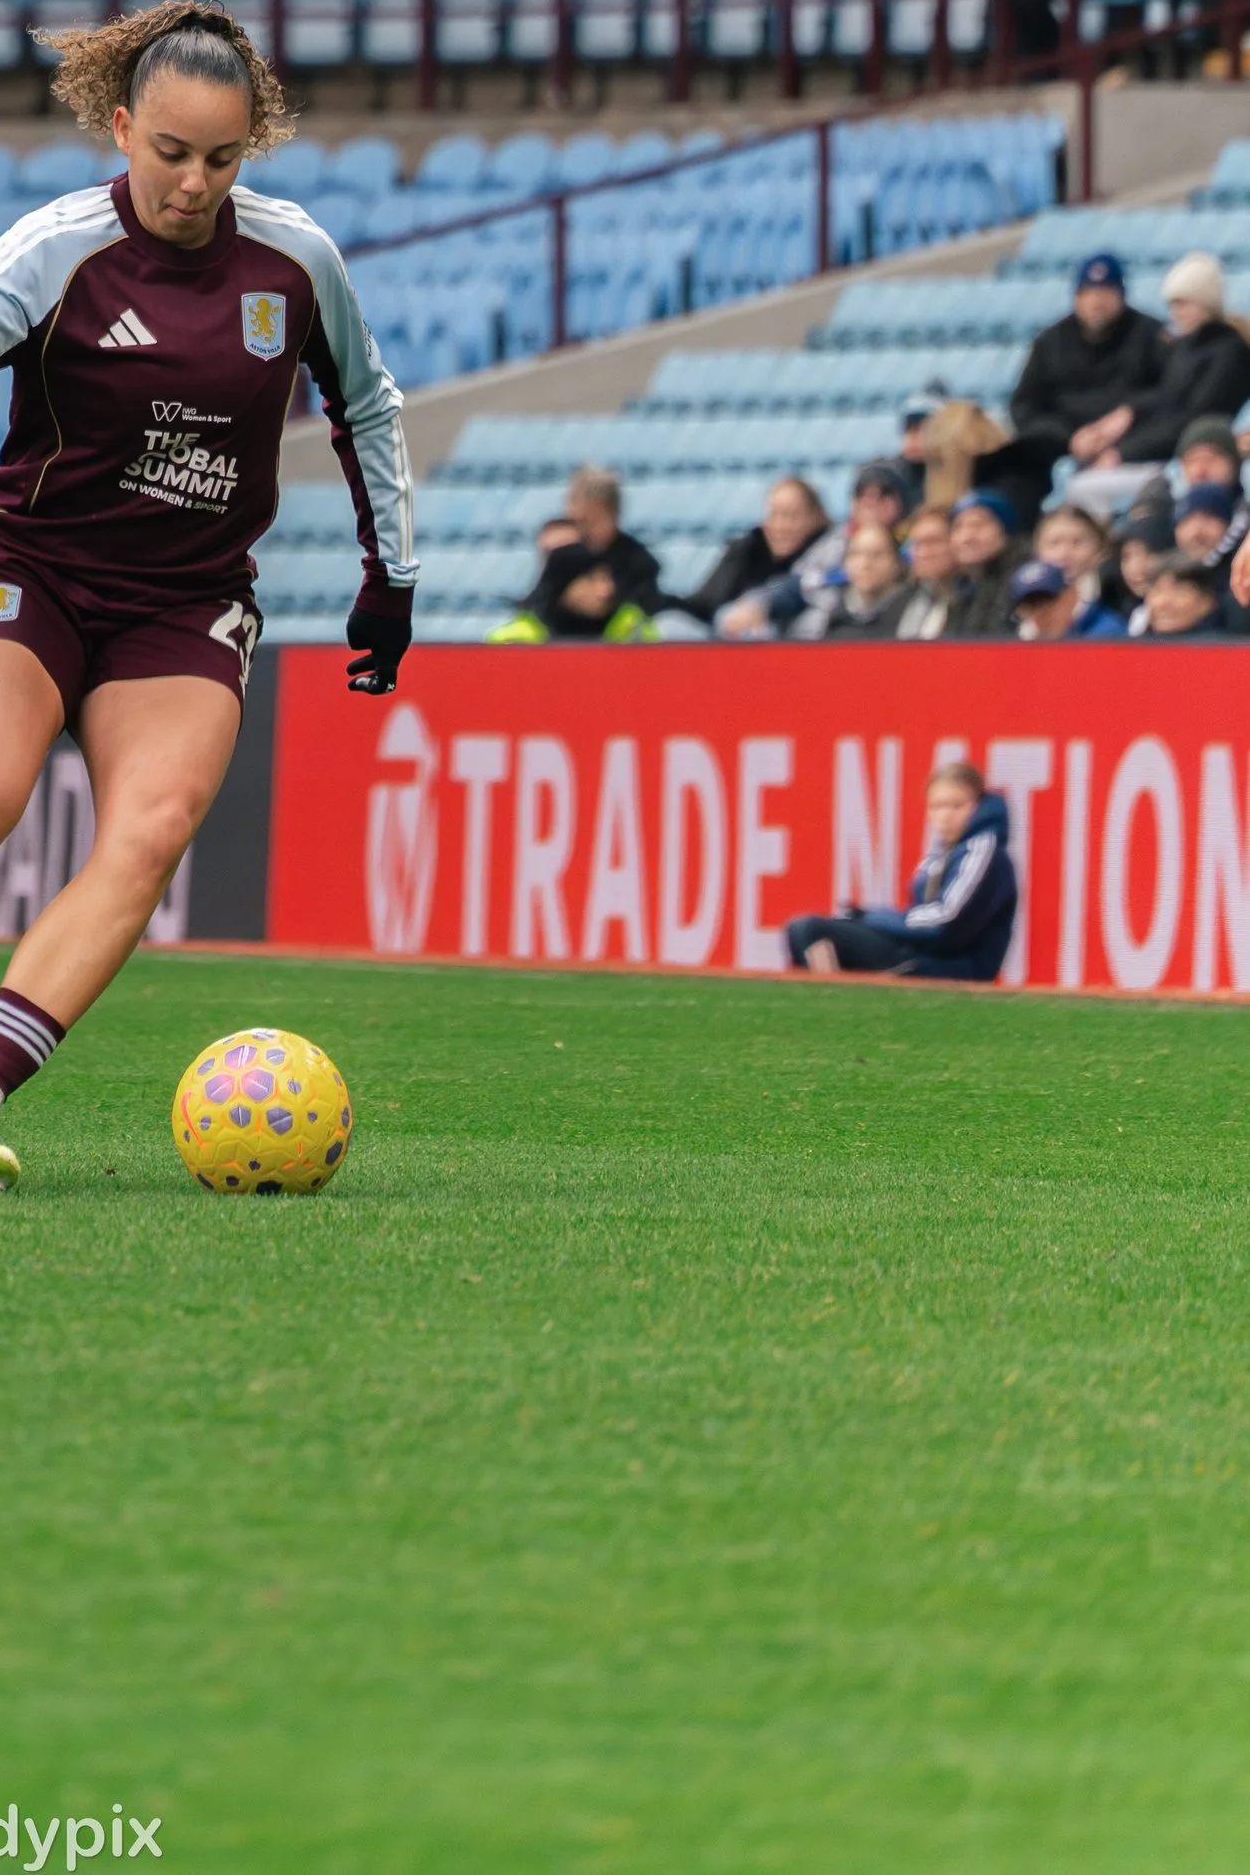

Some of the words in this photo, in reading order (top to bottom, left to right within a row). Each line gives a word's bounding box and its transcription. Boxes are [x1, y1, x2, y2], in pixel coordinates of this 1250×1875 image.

[182, 407, 197, 415] IWG
[182, 414, 207, 422] Women
[213, 415, 232, 424] Sport
[119, 479, 138, 492] ON
[139, 484, 184, 507] WOMEN
[184, 499, 193, 509] &
[193, 501, 228, 514] SPORT
[124, 458, 237, 501] SUMMIT
[450, 734, 794, 971] TRADE
